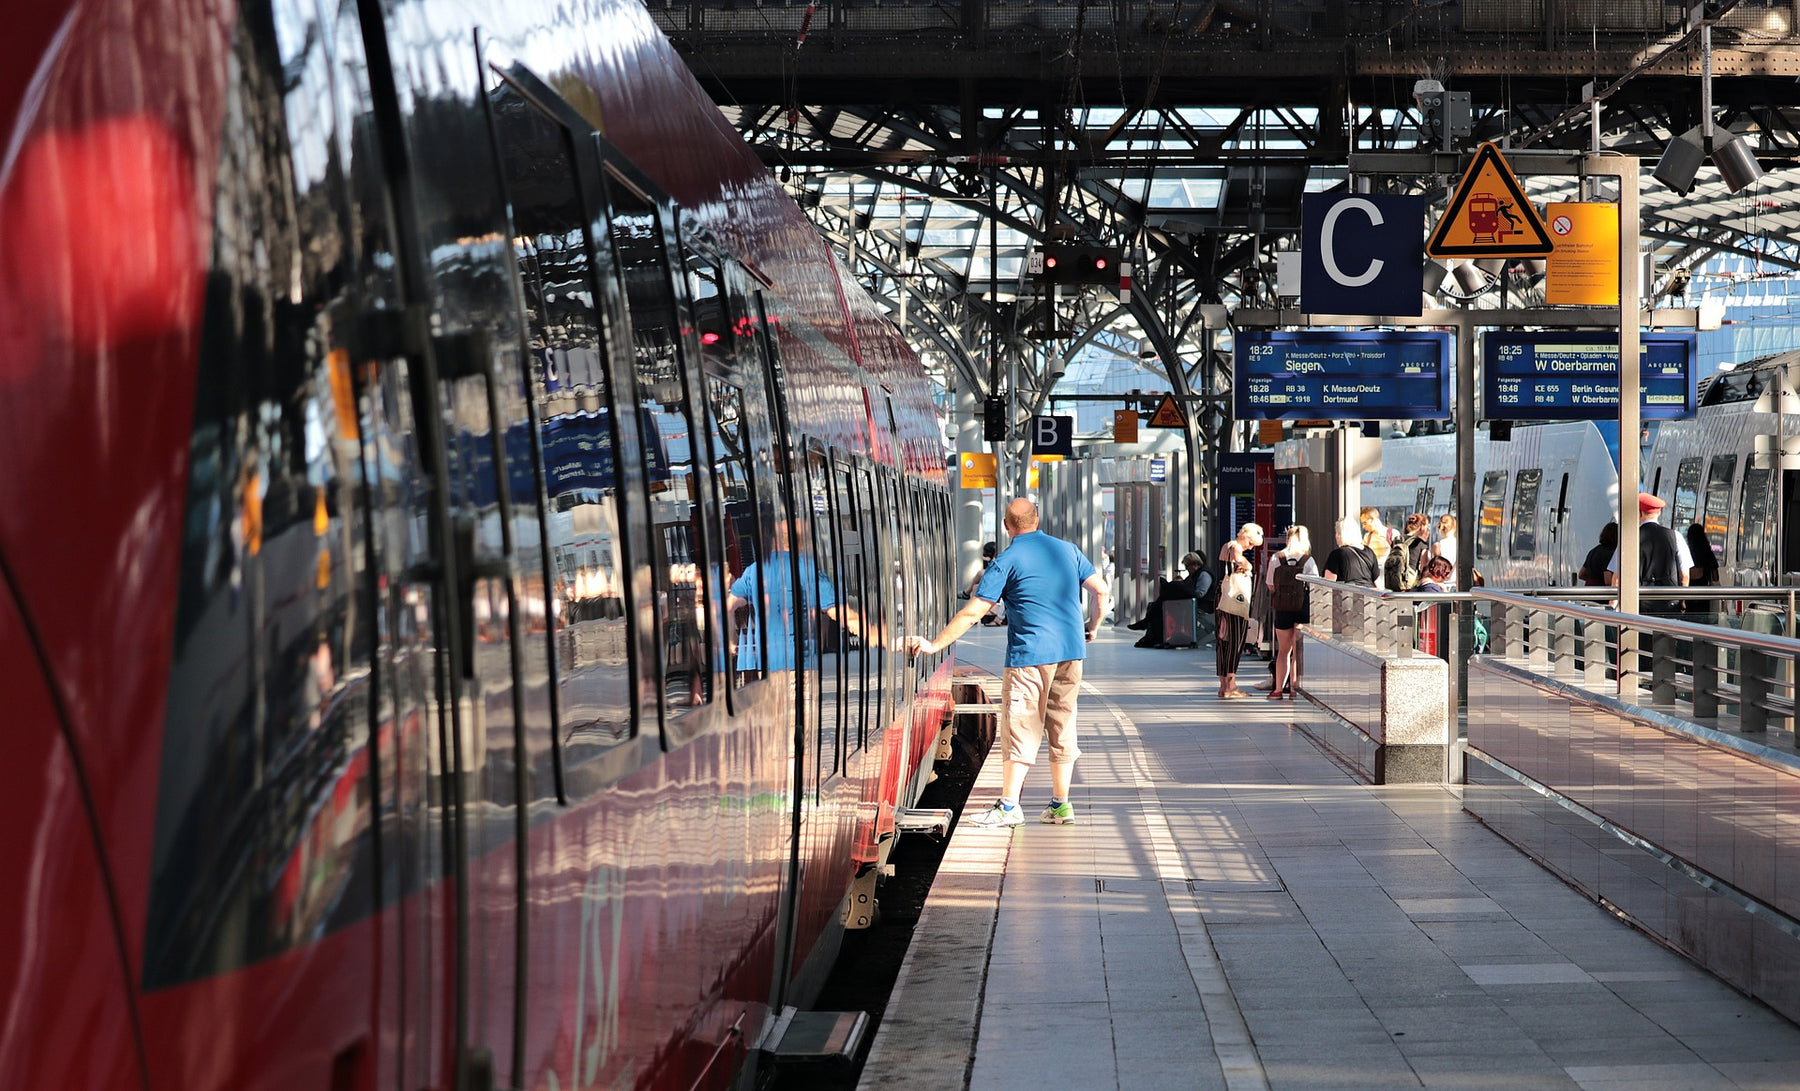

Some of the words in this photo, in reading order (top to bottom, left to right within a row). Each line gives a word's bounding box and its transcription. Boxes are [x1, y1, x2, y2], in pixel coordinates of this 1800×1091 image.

[1320, 197, 1384, 287] C
[1249, 346, 1273, 355] 18:23
[1498, 346, 1522, 355] 18:25
[1286, 360, 1320, 374] Siegen
[1535, 360, 1547, 371] W
[1551, 360, 1616, 371] Oberbarmen
[1498, 385, 1519, 393] 18:48
[1572, 385, 1593, 393] Berlin
[1037, 417, 1058, 446] B
